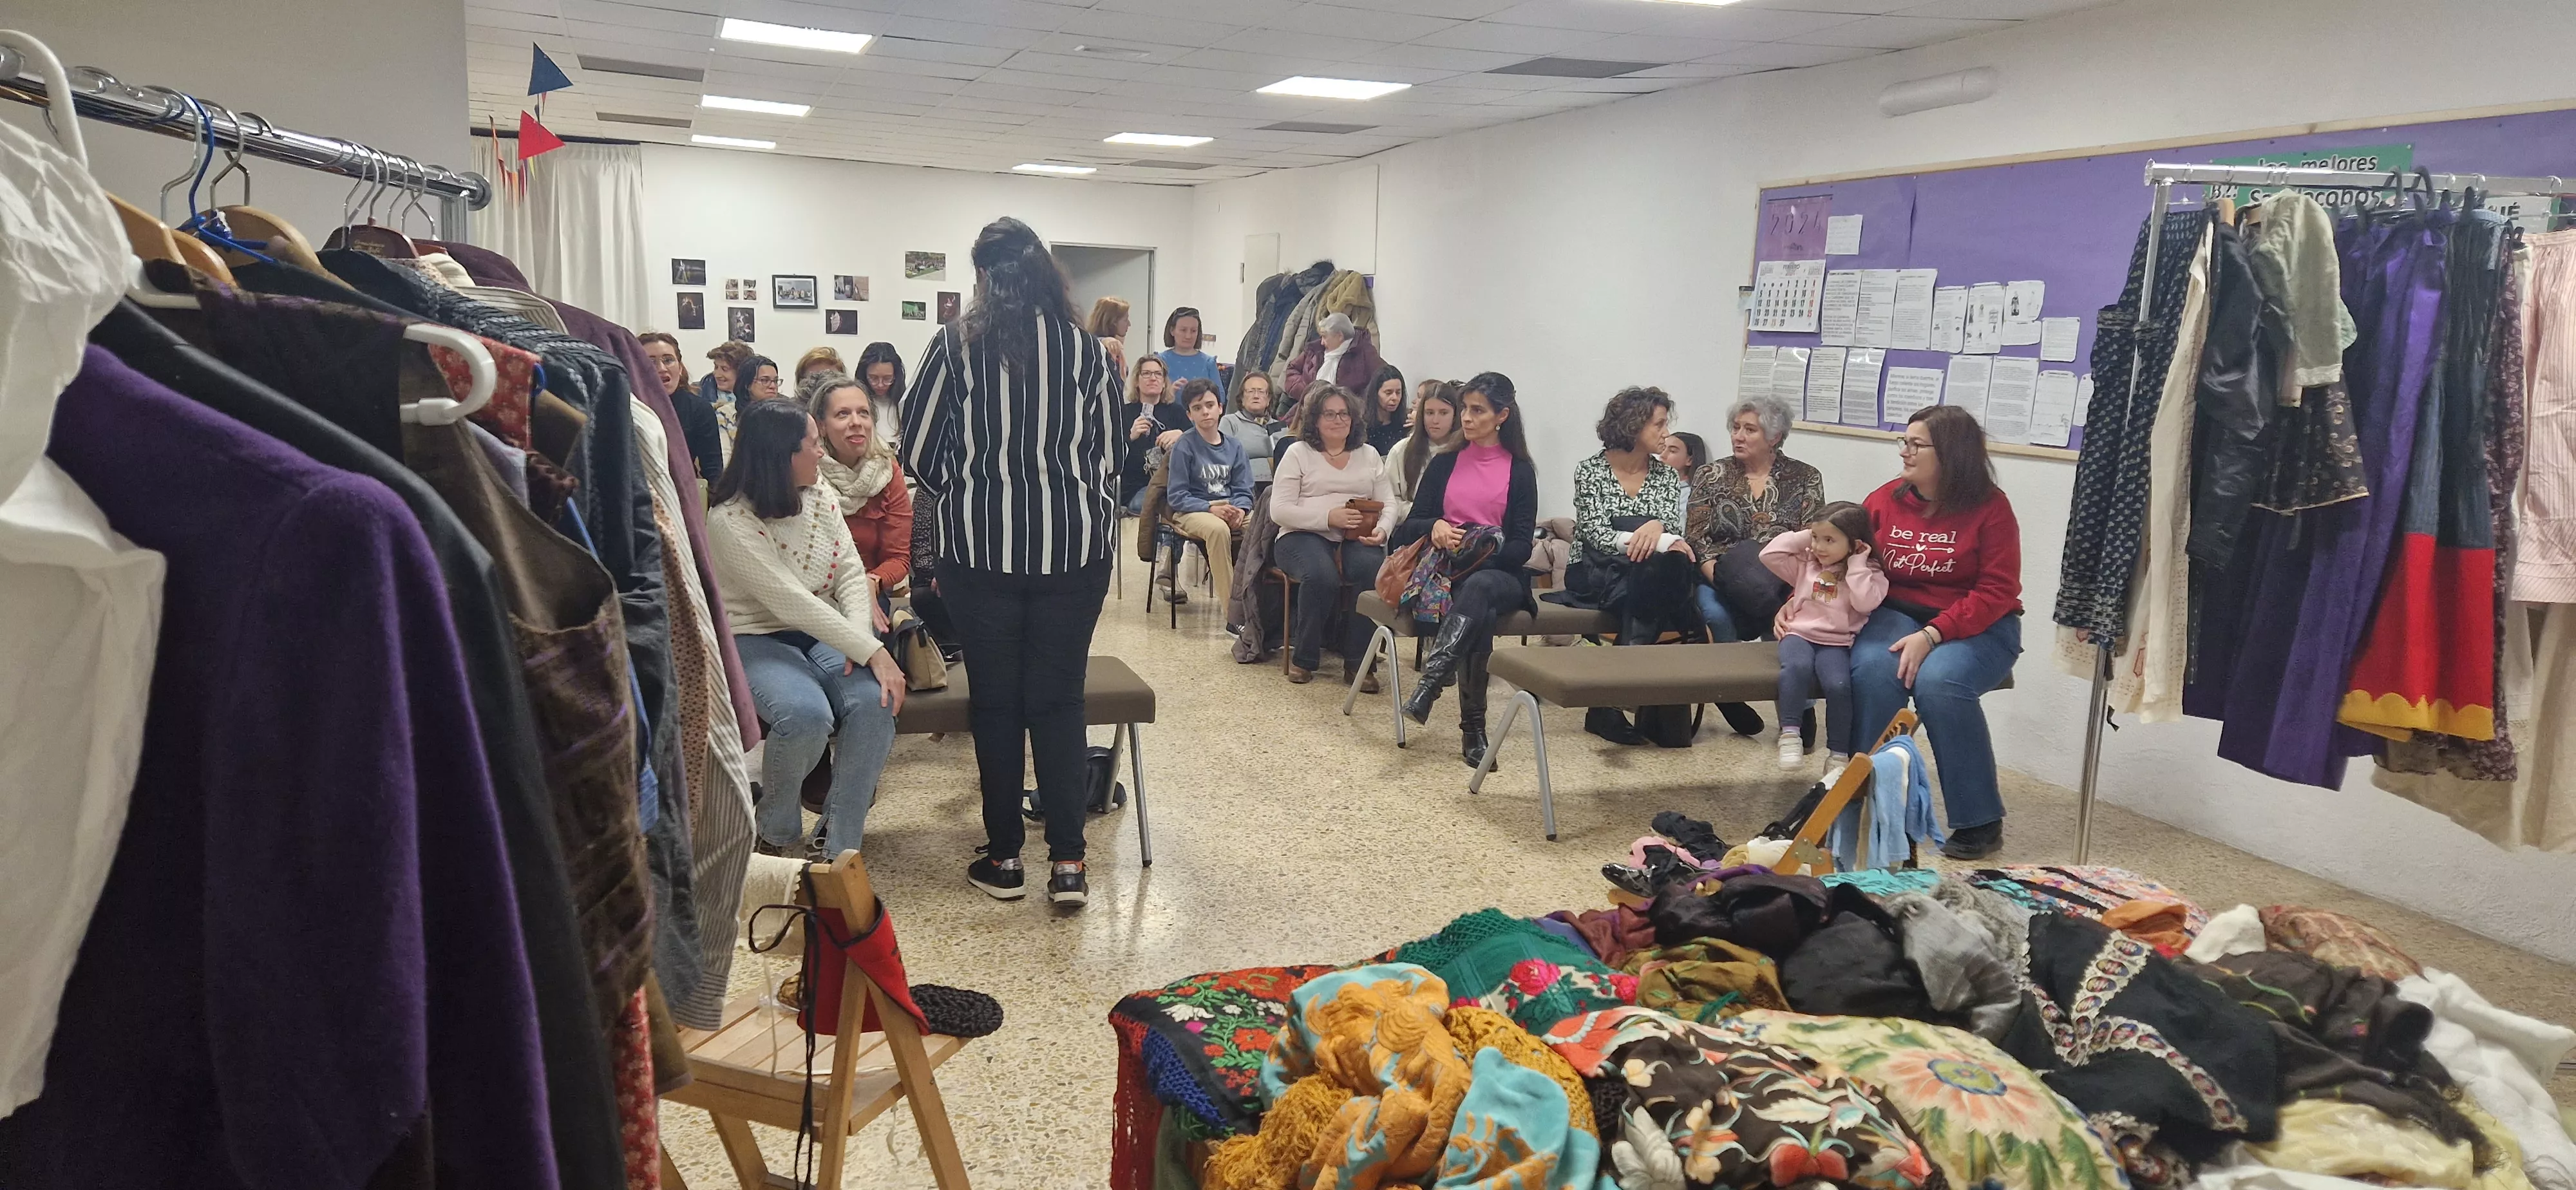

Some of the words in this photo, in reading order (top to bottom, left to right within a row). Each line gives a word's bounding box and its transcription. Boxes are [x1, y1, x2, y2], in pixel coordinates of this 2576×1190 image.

[1770, 211, 1822, 236] 2024
[1889, 525, 1913, 540] be
[1918, 531, 1956, 543] real
[1882, 547, 1906, 571] Not
[1904, 553, 1956, 577] Perfect
